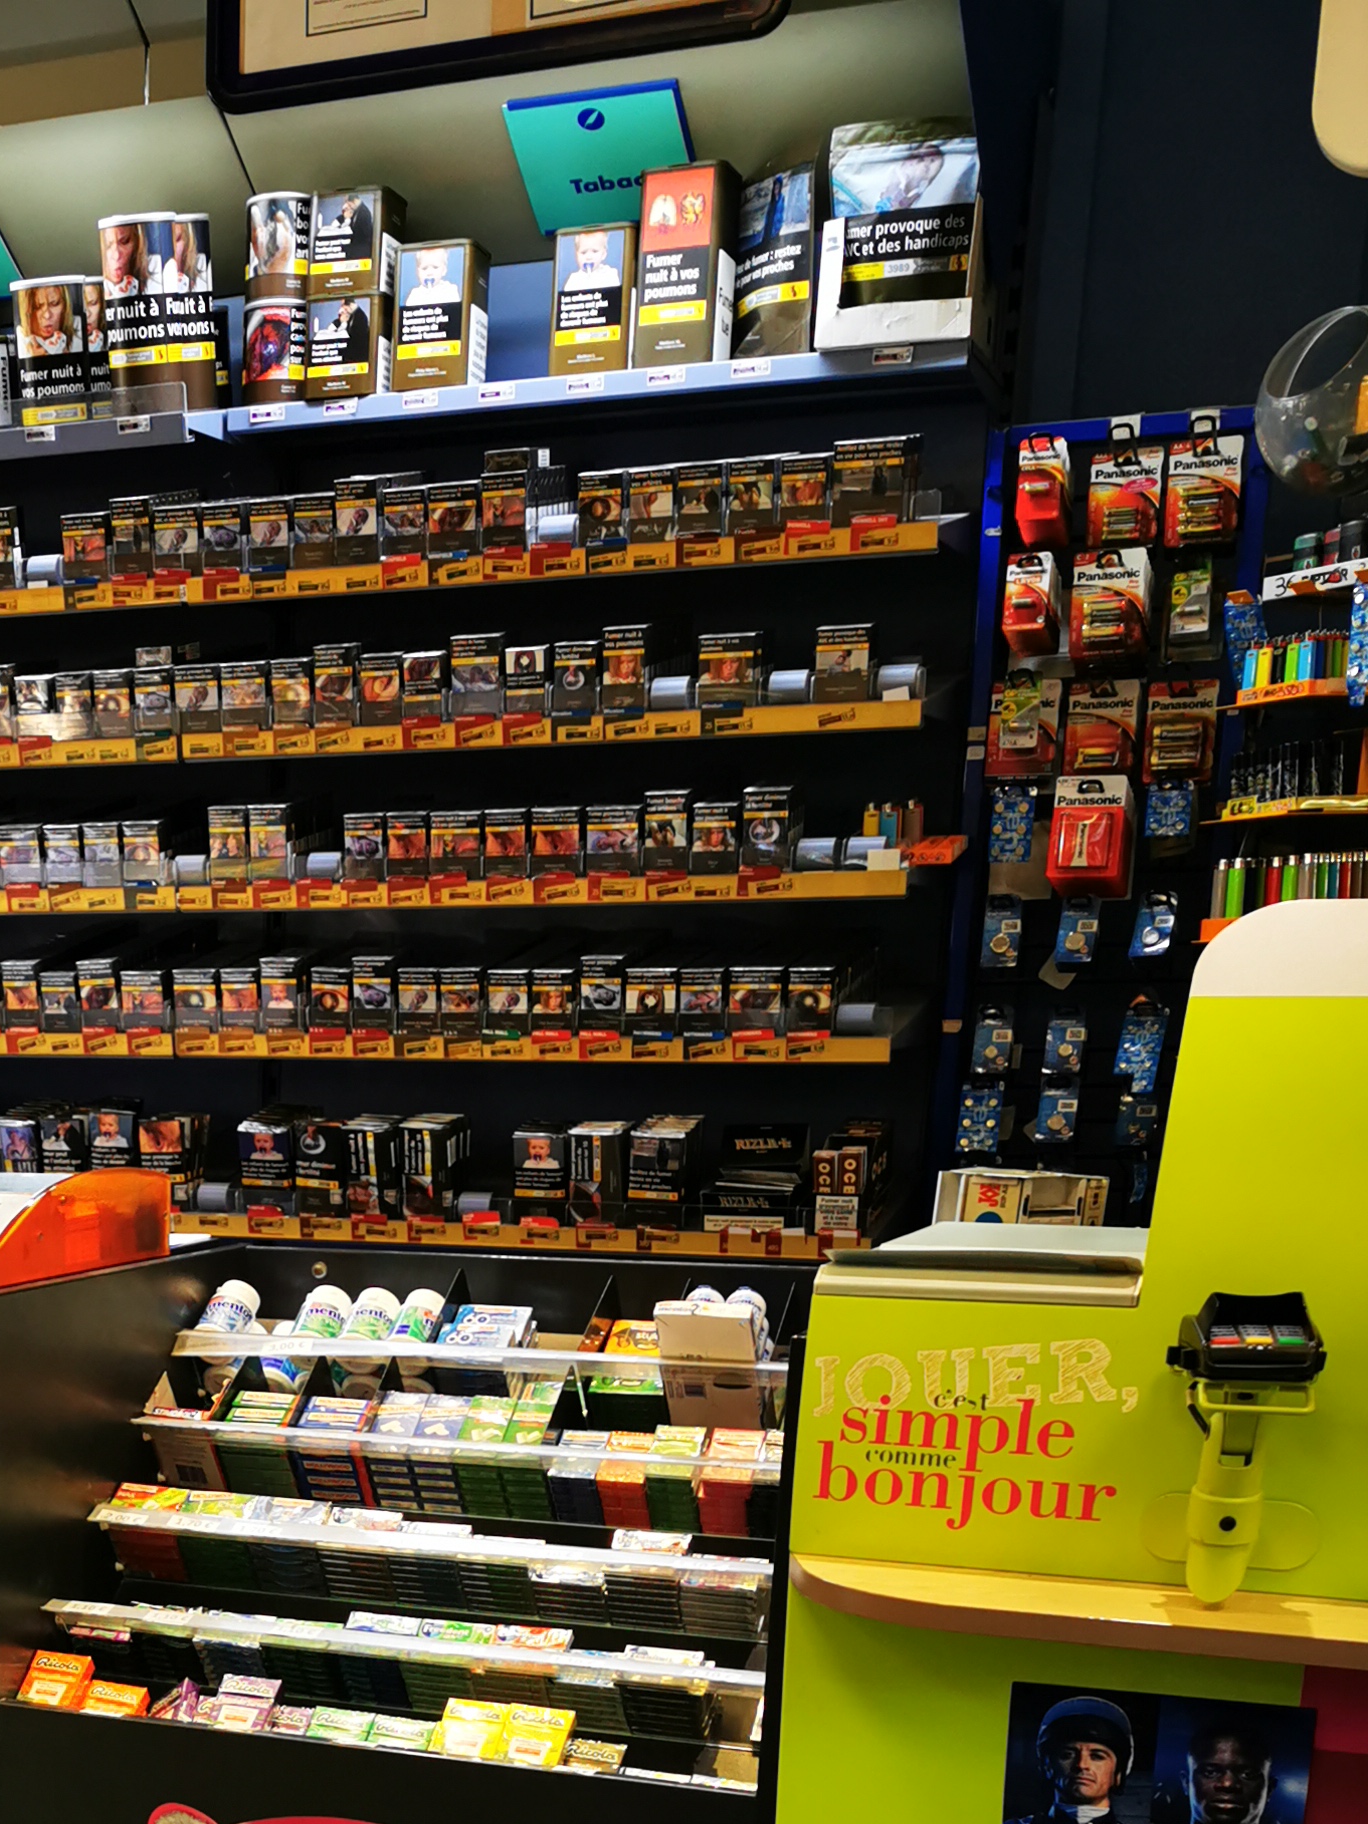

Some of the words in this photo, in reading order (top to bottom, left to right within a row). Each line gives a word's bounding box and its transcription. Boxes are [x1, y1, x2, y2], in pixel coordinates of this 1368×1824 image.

[875, 218, 941, 240] provoque
[944, 213, 965, 229] des
[774, 244, 802, 259] restez
[862, 243, 875, 256] et
[878, 239, 901, 254] des
[904, 232, 970, 252] handicaps
[646, 254, 683, 268] Fumer
[762, 259, 795, 279] proches
[887, 263, 911, 274] 3989
[645, 269, 668, 283] nuit
[670, 269, 678, 281] à
[679, 267, 700, 279] vos
[644, 283, 697, 302] poumons
[117, 302, 145, 320] nuit
[149, 298, 160, 316] à
[20, 368, 49, 383] Fumer
[51, 366, 74, 380] nuit
[75, 364, 83, 377] à
[37, 381, 85, 401] poumons
[1021, 452, 1061, 463] Panasonic
[1173, 455, 1239, 471] Panasonic
[1095, 466, 1158, 480] Panasonic
[1077, 567, 1141, 582] Panasonic
[1072, 699, 1134, 711] Panasonic
[1151, 699, 1214, 711] Panasonic
[1057, 794, 1123, 806] Panasonic
[306, 1306, 344, 1324] mento
[813, 1338, 1139, 1418] JOUER,
[933, 1389, 989, 1412] c'est
[840, 1394, 1075, 1473] simple
[865, 1449, 957, 1469] comme
[813, 1440, 1118, 1531] bonjour
[35, 1656, 81, 1673] Ricola
[90, 1686, 137, 1702] Ricola
[222, 1679, 272, 1696] Ricola
[565, 1742, 620, 1762] Ricola
